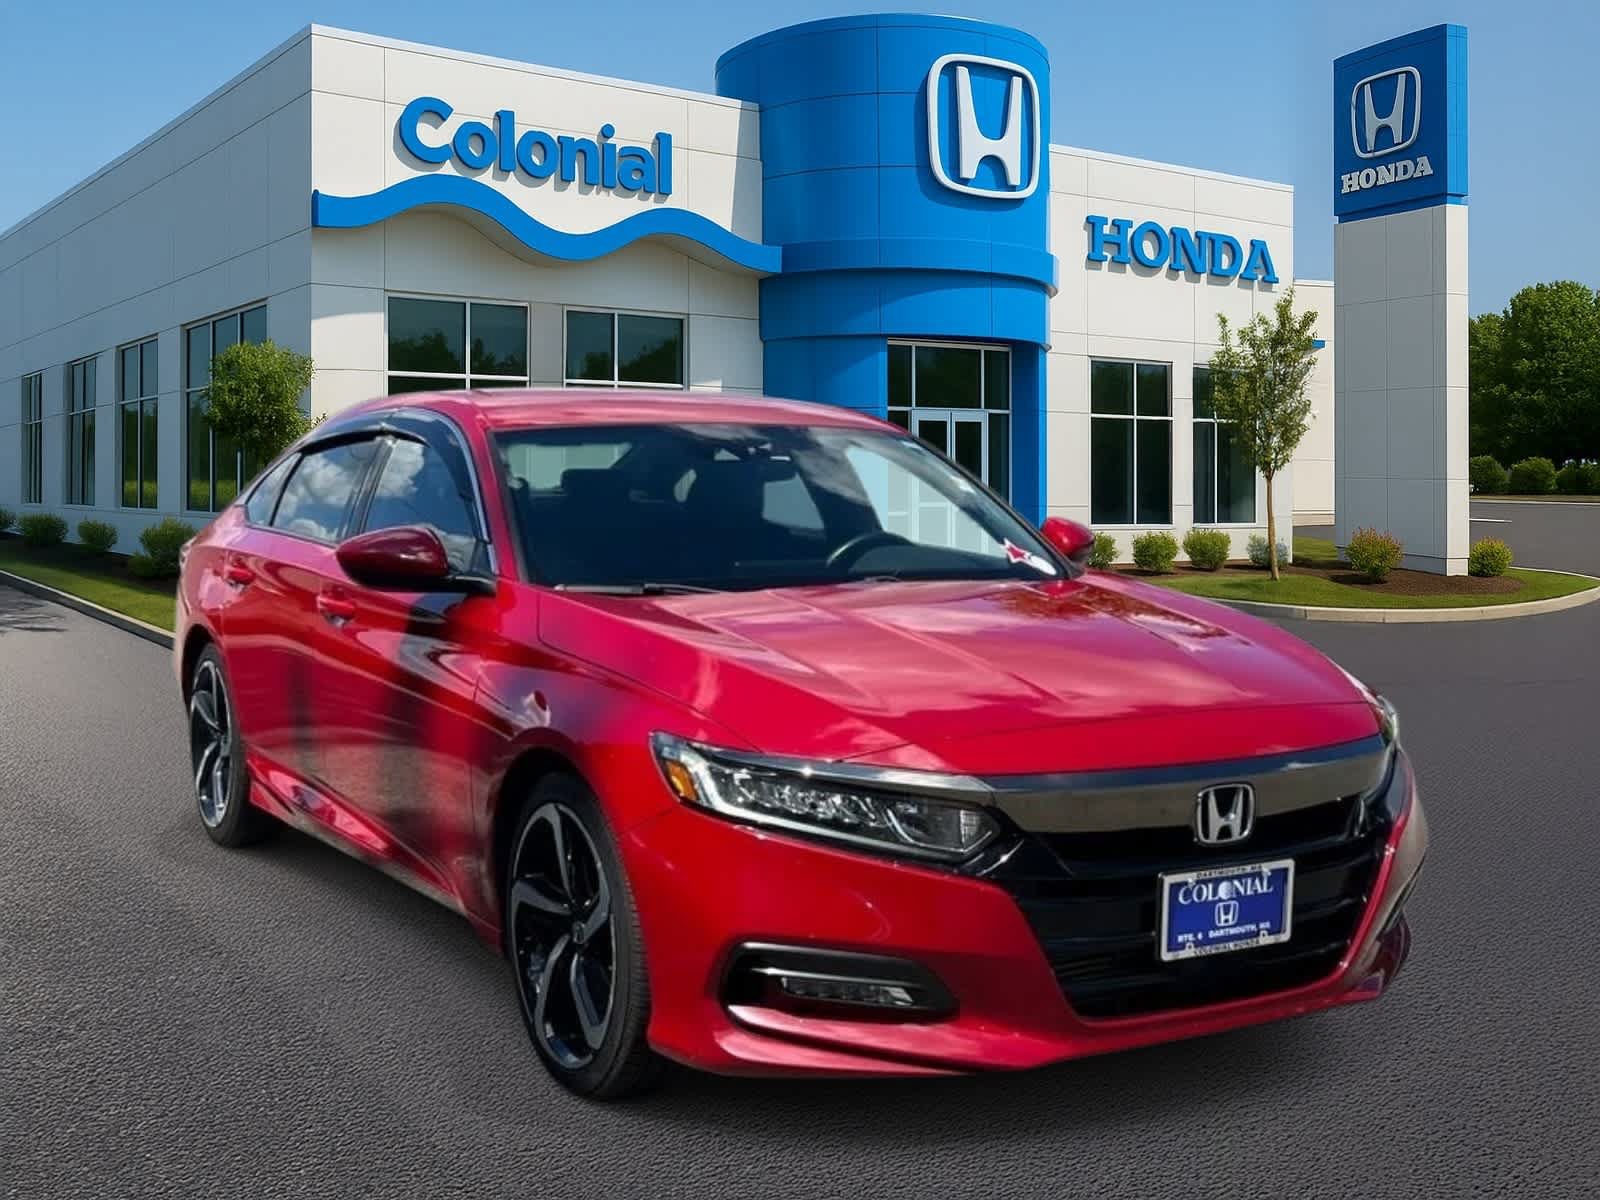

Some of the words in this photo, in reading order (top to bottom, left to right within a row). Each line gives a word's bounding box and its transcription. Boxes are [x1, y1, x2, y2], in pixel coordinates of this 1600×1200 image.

[400, 96, 673, 195] Colonial
[1341, 156, 1434, 194] HONDA
[1086, 215, 1280, 284] HONDA
[1178, 876, 1273, 904] COLONIAL
